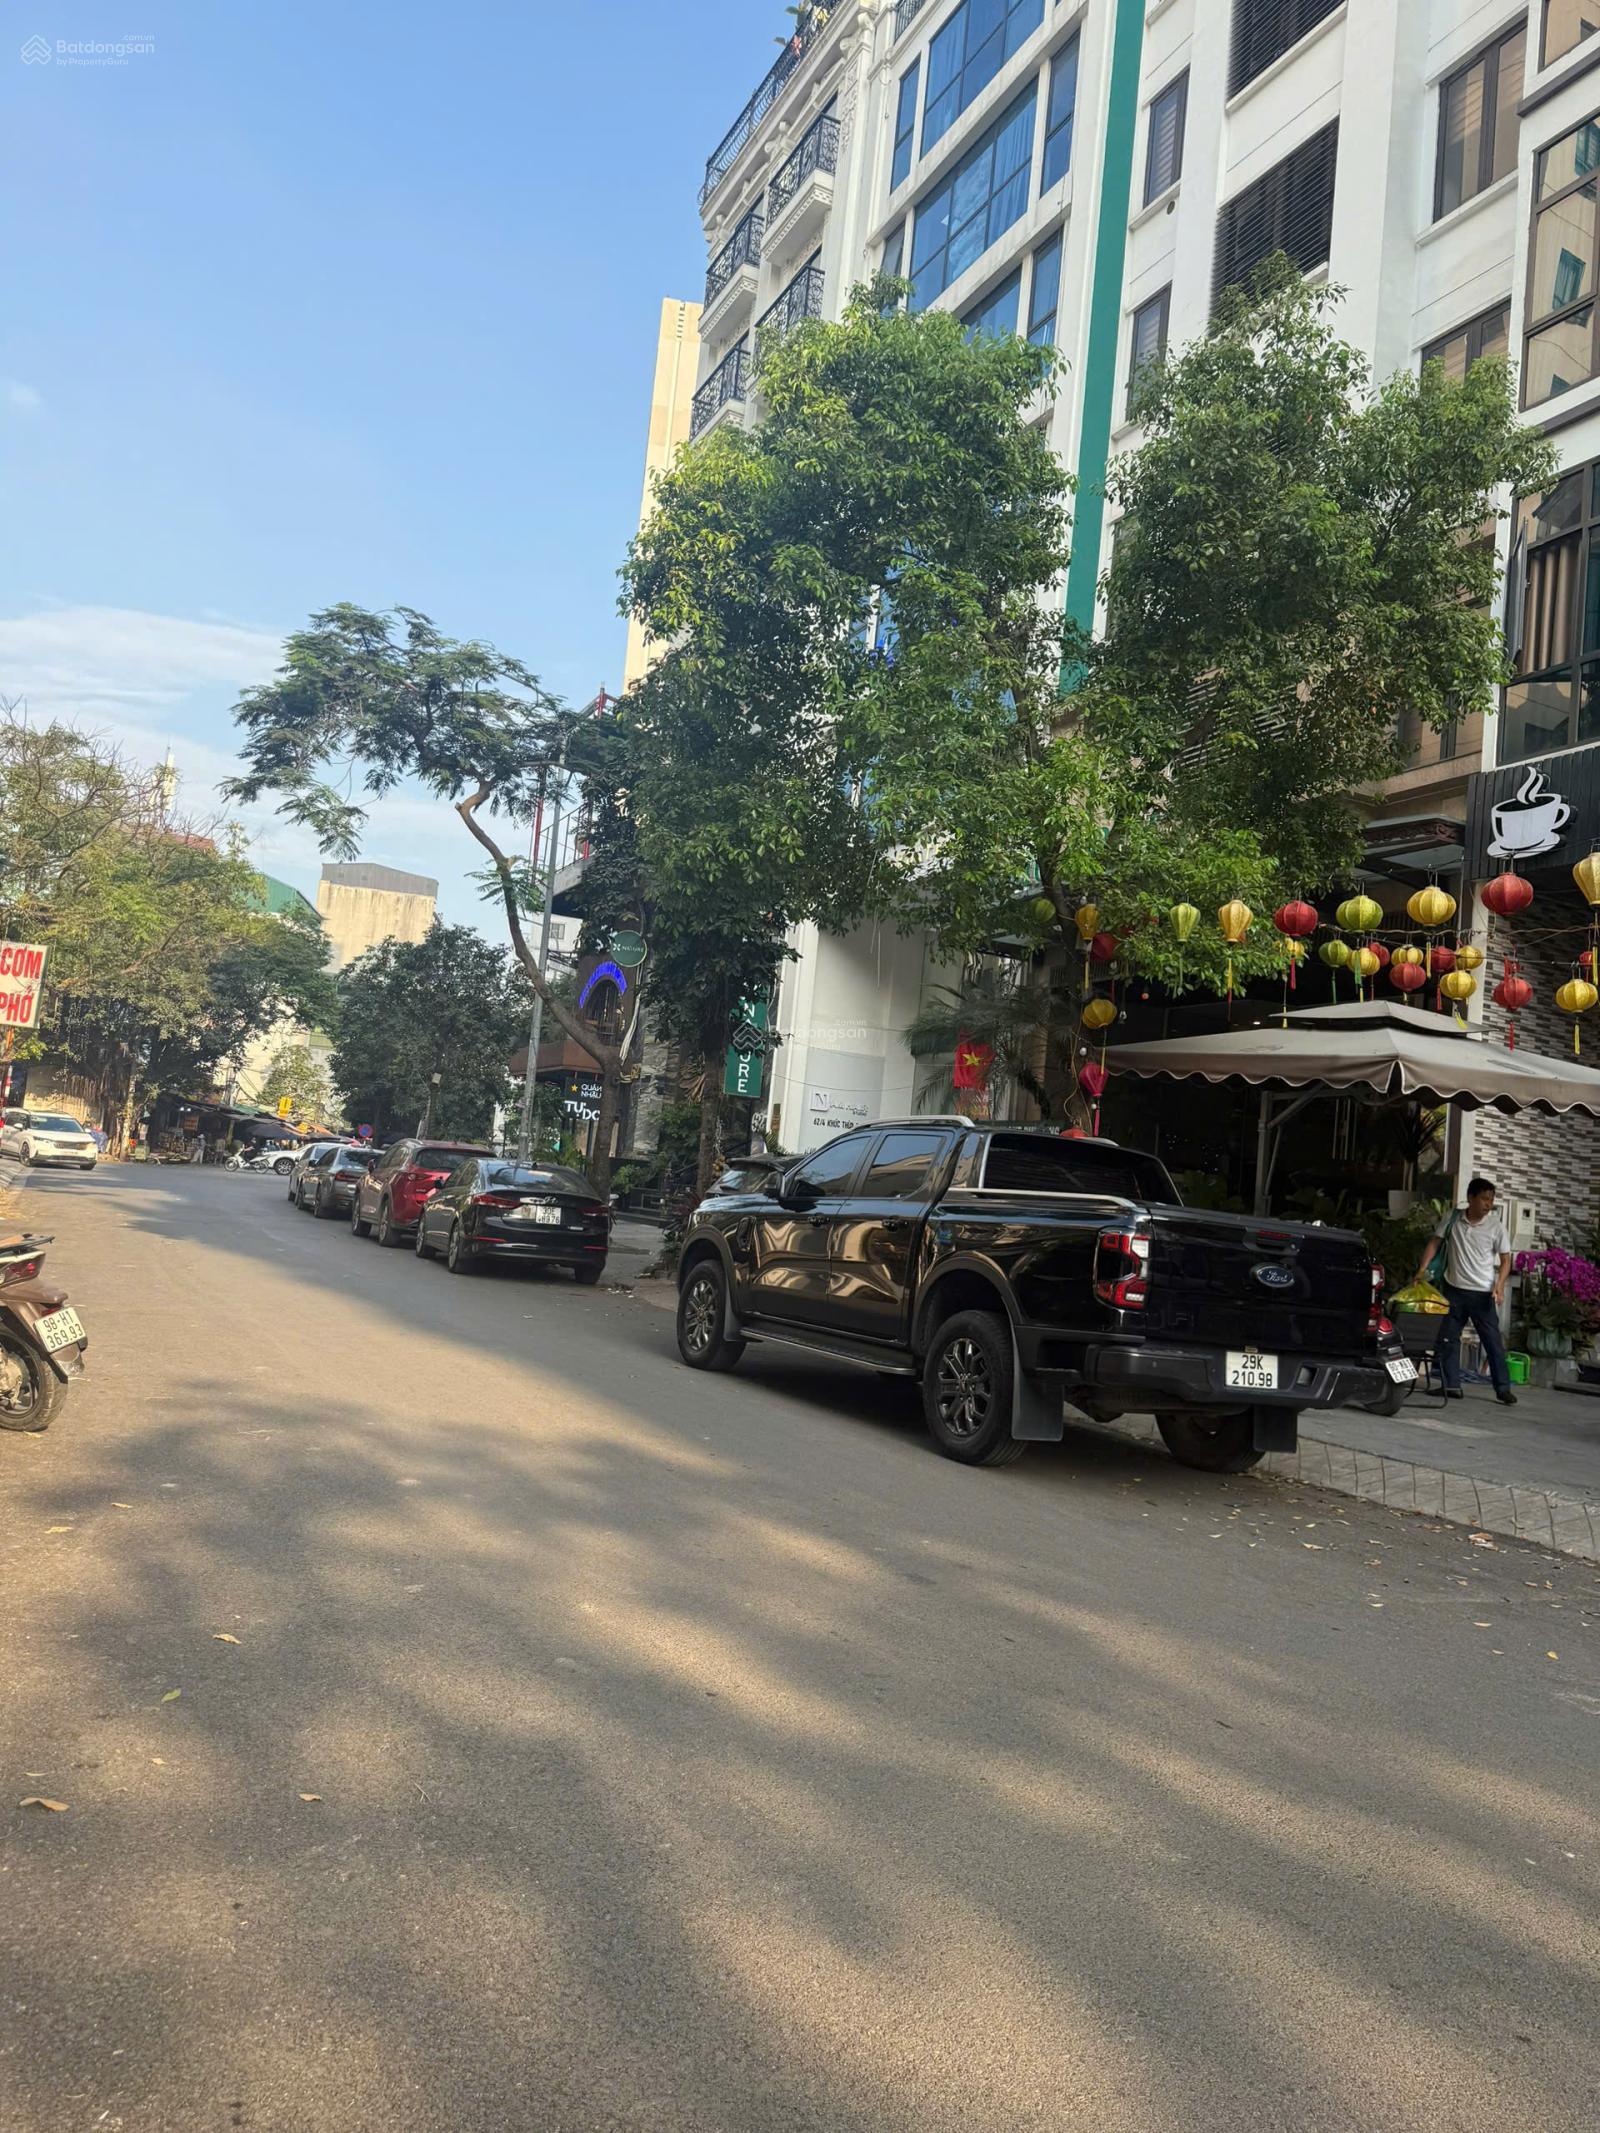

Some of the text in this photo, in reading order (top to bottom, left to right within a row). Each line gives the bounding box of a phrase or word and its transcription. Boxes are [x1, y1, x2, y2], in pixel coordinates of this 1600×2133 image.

[0, 946, 43, 979] CƠM
[737, 1003, 756, 1093] NURE
[1266, 1270, 1288, 1282] Ford
[43, 1310, 74, 1333] 98-H1
[46, 1323, 83, 1348] 369.93
[1241, 1354, 1264, 1370] 29K
[1231, 1370, 1273, 1387] 210.98
